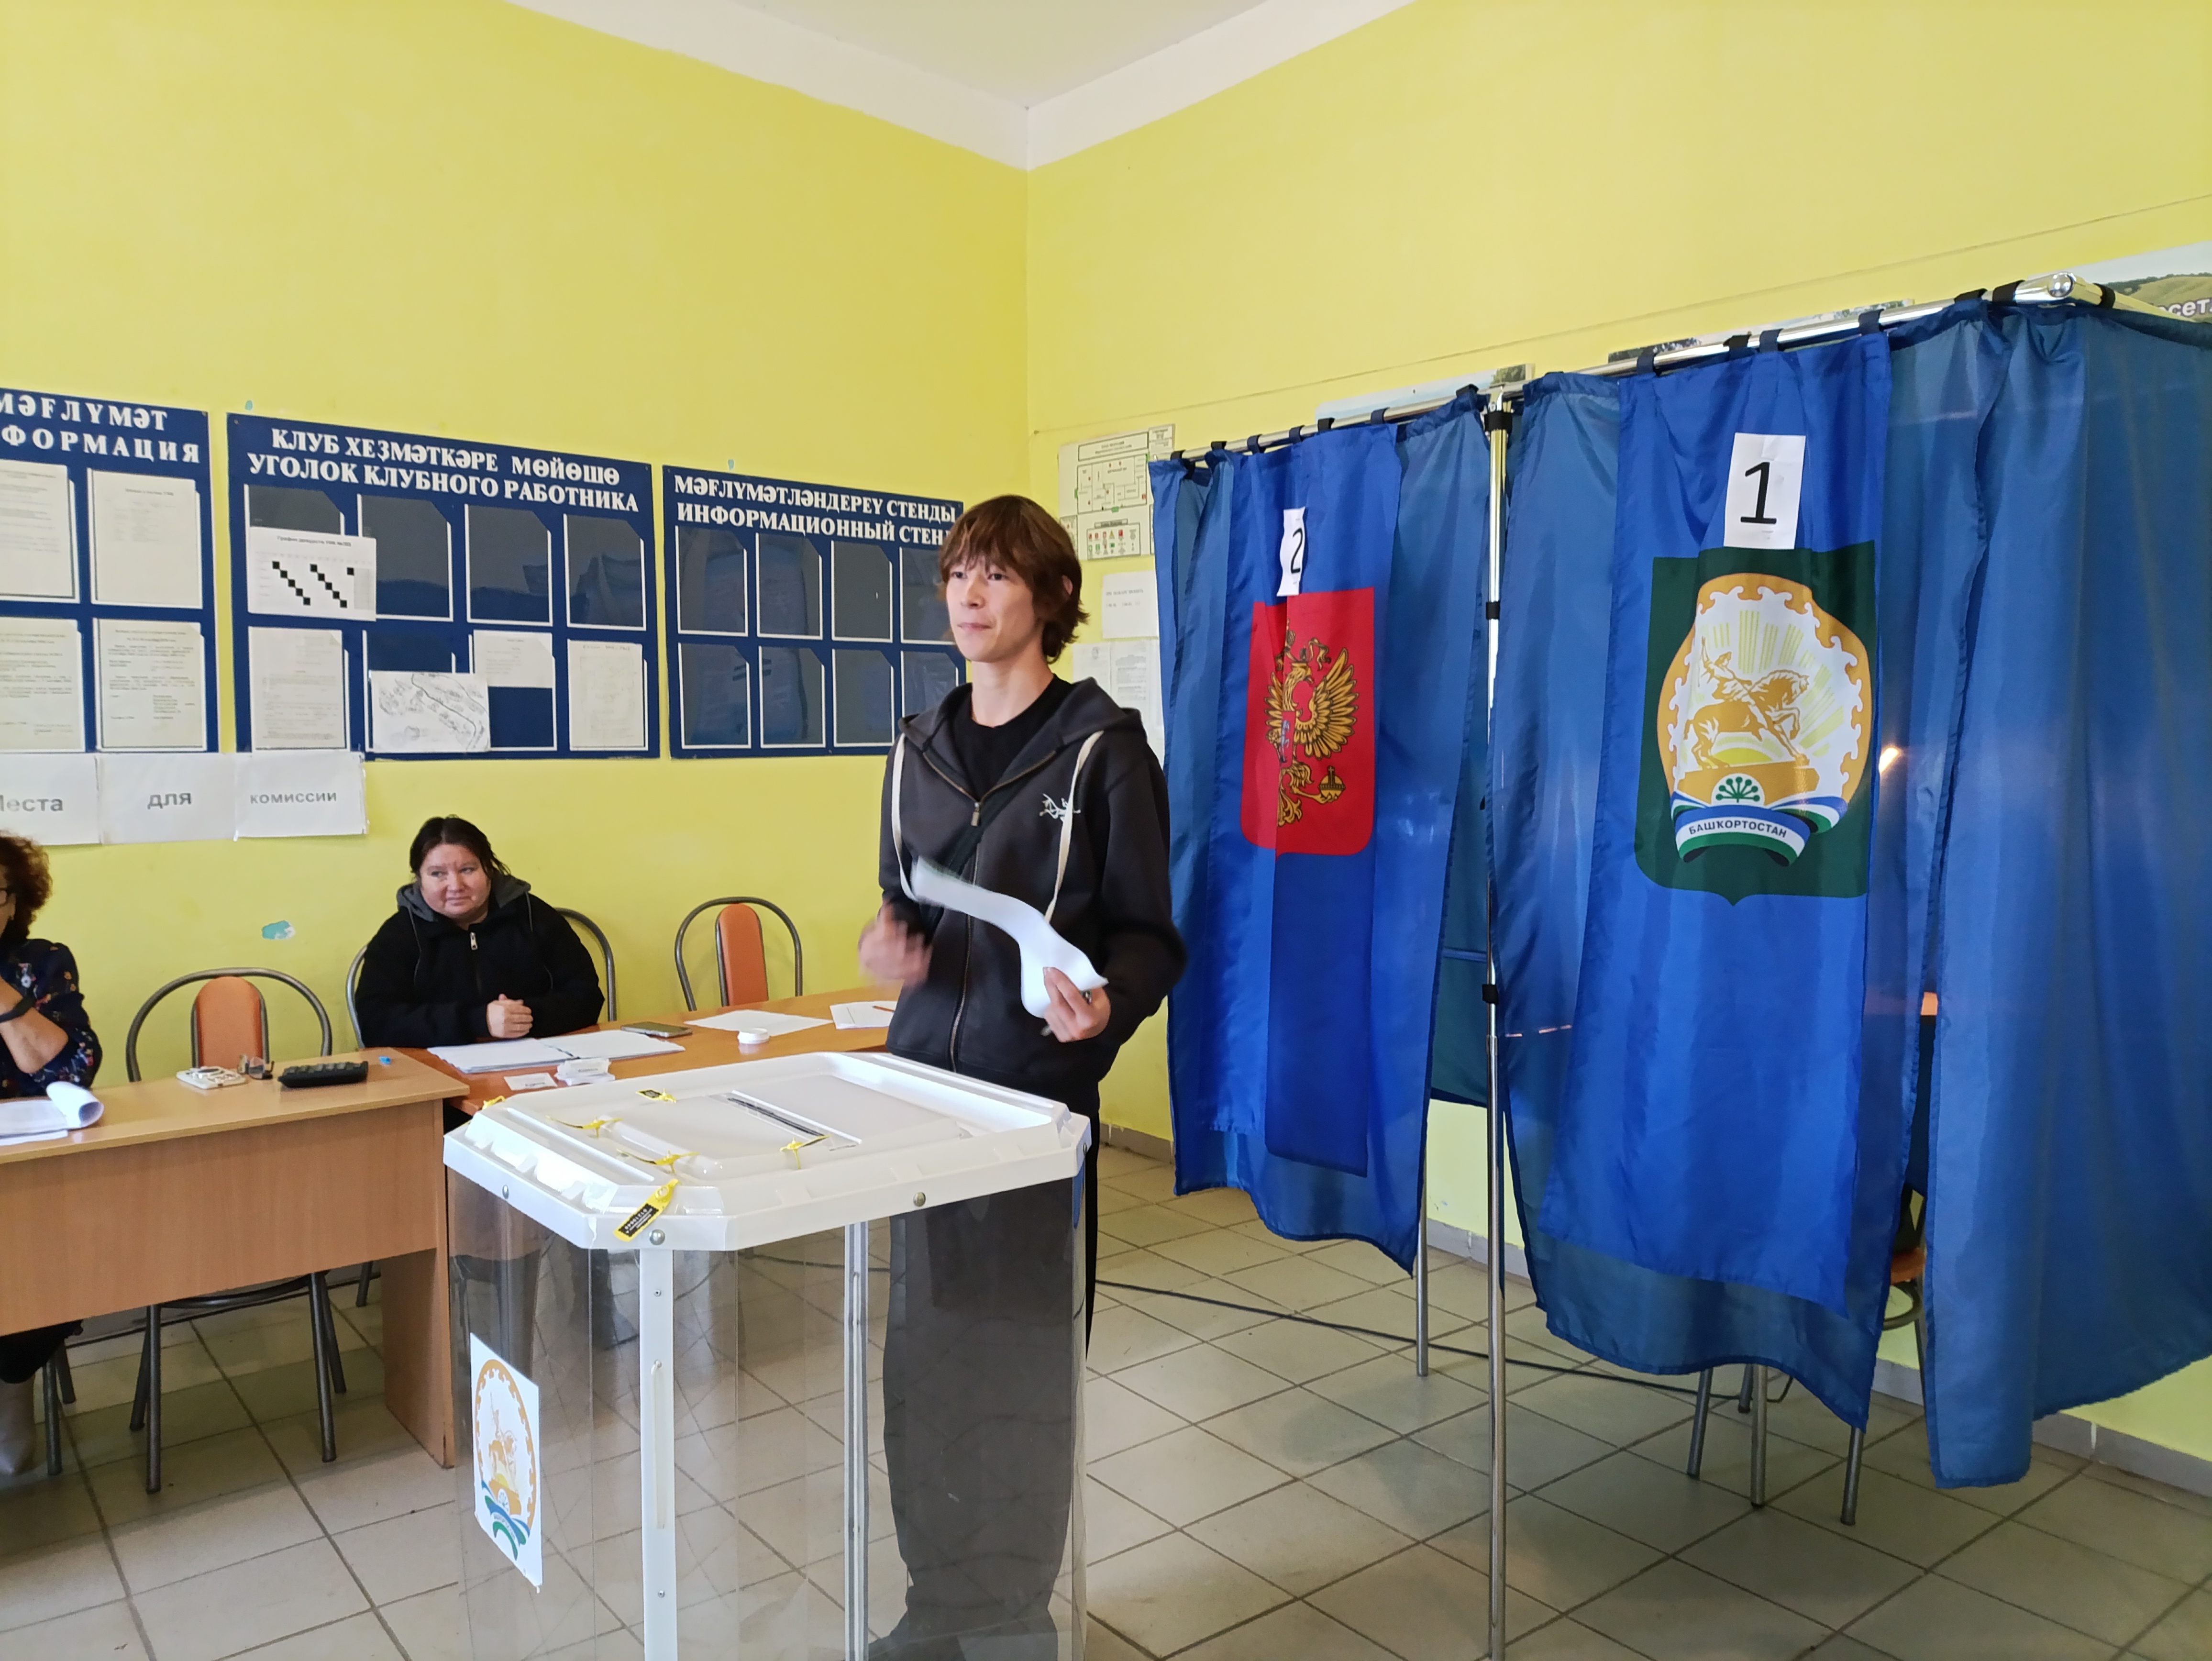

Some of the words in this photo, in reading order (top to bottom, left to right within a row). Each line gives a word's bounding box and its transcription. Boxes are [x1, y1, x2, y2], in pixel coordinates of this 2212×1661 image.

[2158, 299, 2212, 316] сет
[2, 425, 199, 463] ФОРМАЦИЯ
[271, 428, 340, 454] КЛУБ
[345, 436, 498, 472] ХЕҘМӘТКӘРЕ
[511, 456, 620, 486] МӨЙӨШӨ
[247, 453, 359, 483] УГОЛОК
[364, 465, 499, 498] КЛУБНОГО
[504, 479, 639, 512] РАБОТНИКА
[1740, 462, 1777, 524] 1
[677, 502, 895, 542] ИНФОРМАЦИОННЫЙ
[899, 525, 951, 545] СТЕН
[886, 499, 955, 525] СТЕНДЫ
[1291, 528, 1303, 574] 2
[0, 795, 63, 812] еста
[147, 792, 192, 809] для
[250, 790, 337, 804] комиссии
